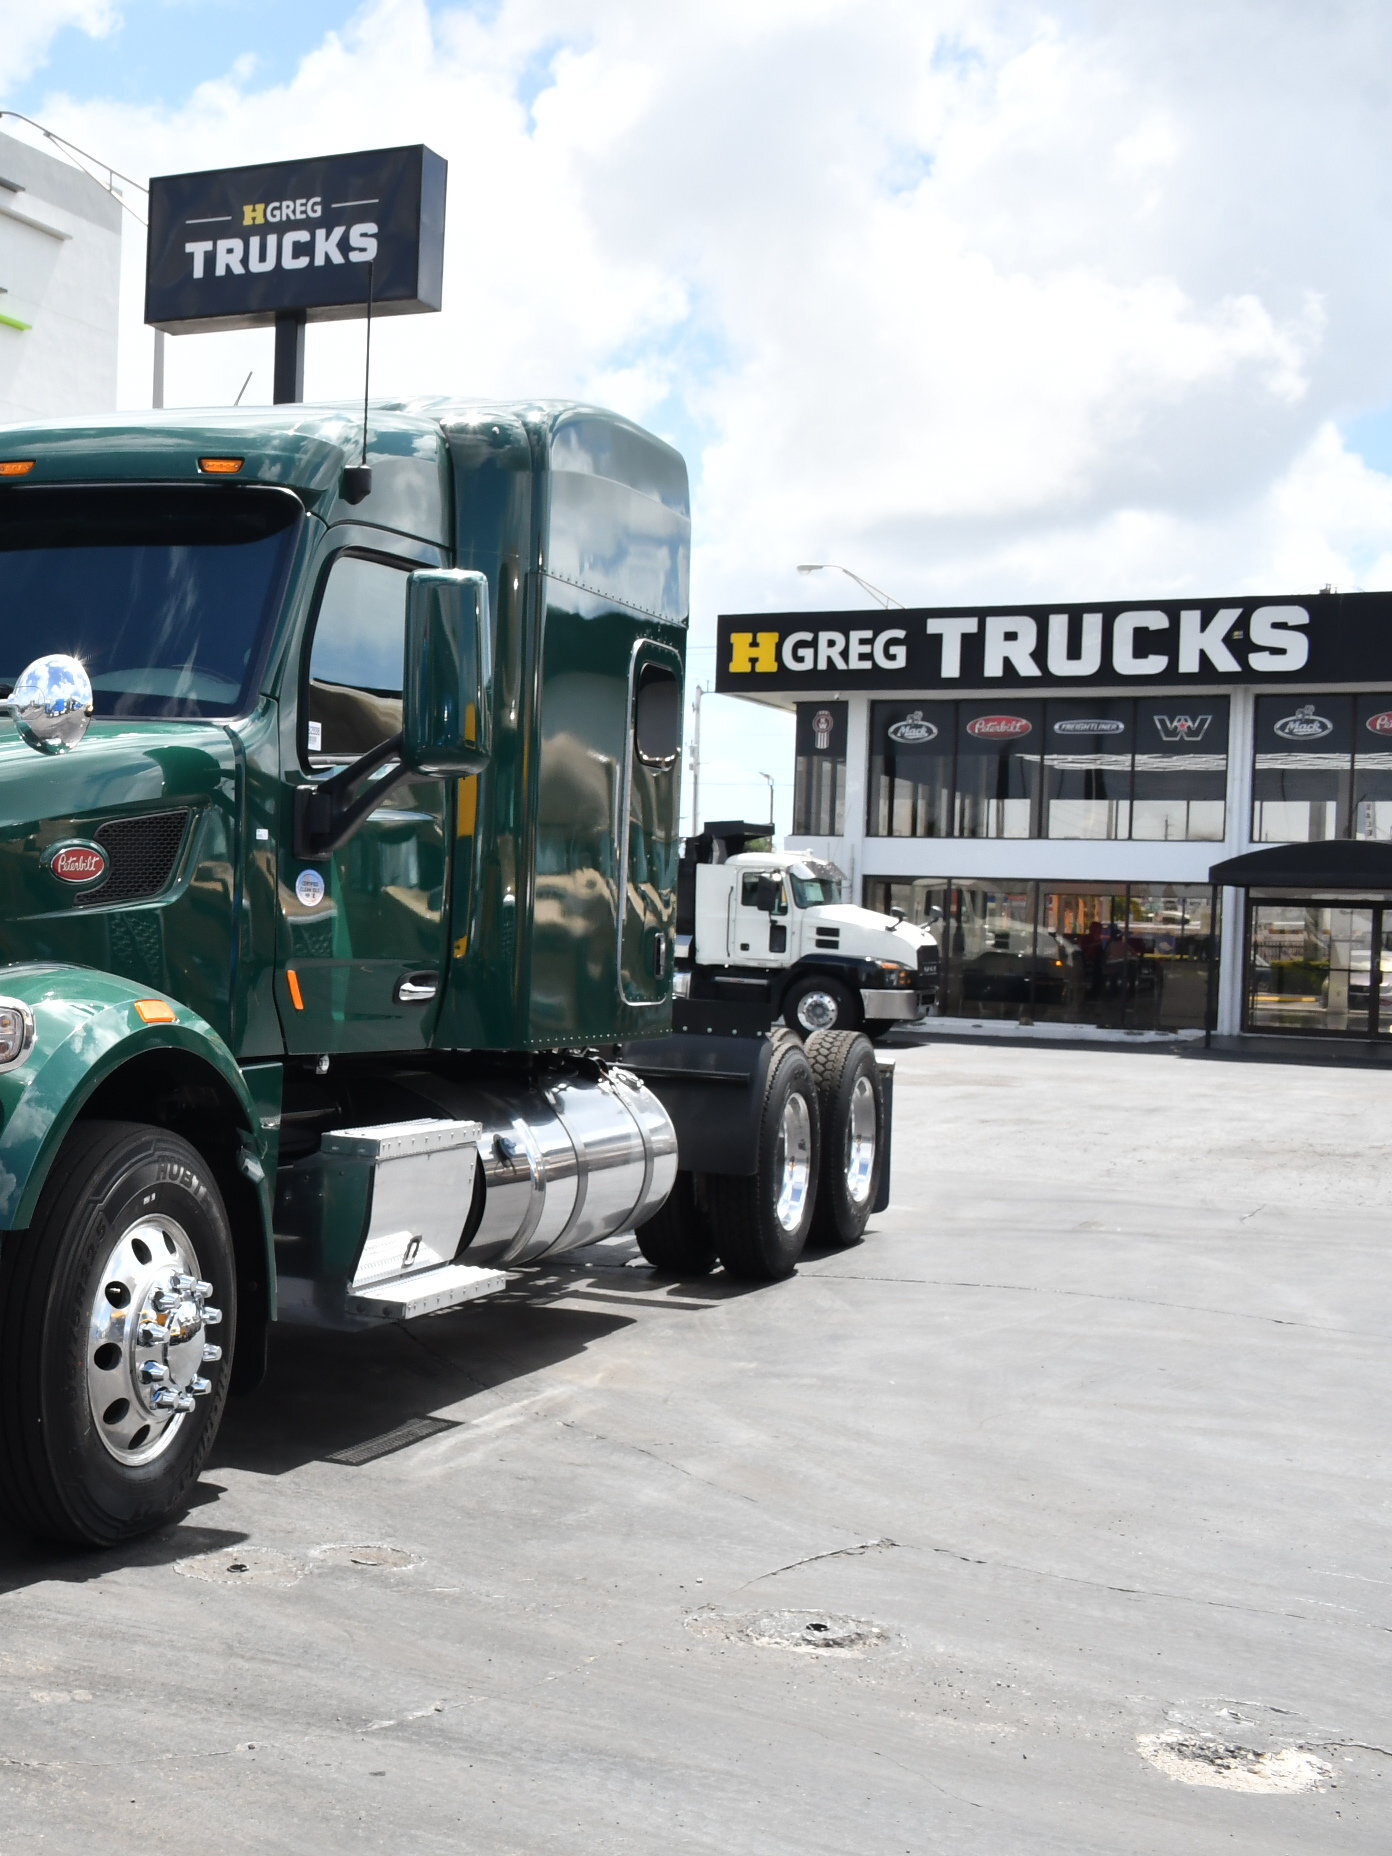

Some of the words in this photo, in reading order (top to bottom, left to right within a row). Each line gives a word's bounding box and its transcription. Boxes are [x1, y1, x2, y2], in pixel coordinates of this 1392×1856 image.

[242, 197, 322, 226] HGREG
[185, 222, 379, 279] TRUCKS
[728, 629, 907, 673] HGREG
[926, 605, 1310, 678] TRUCKS
[897, 725, 929, 738] Mack
[974, 719, 1027, 734] Peterbilt
[1061, 722, 1117, 732] FREIGHTLINER
[1284, 720, 1322, 735] Mack
[58, 854, 99, 873] Peterbilt
